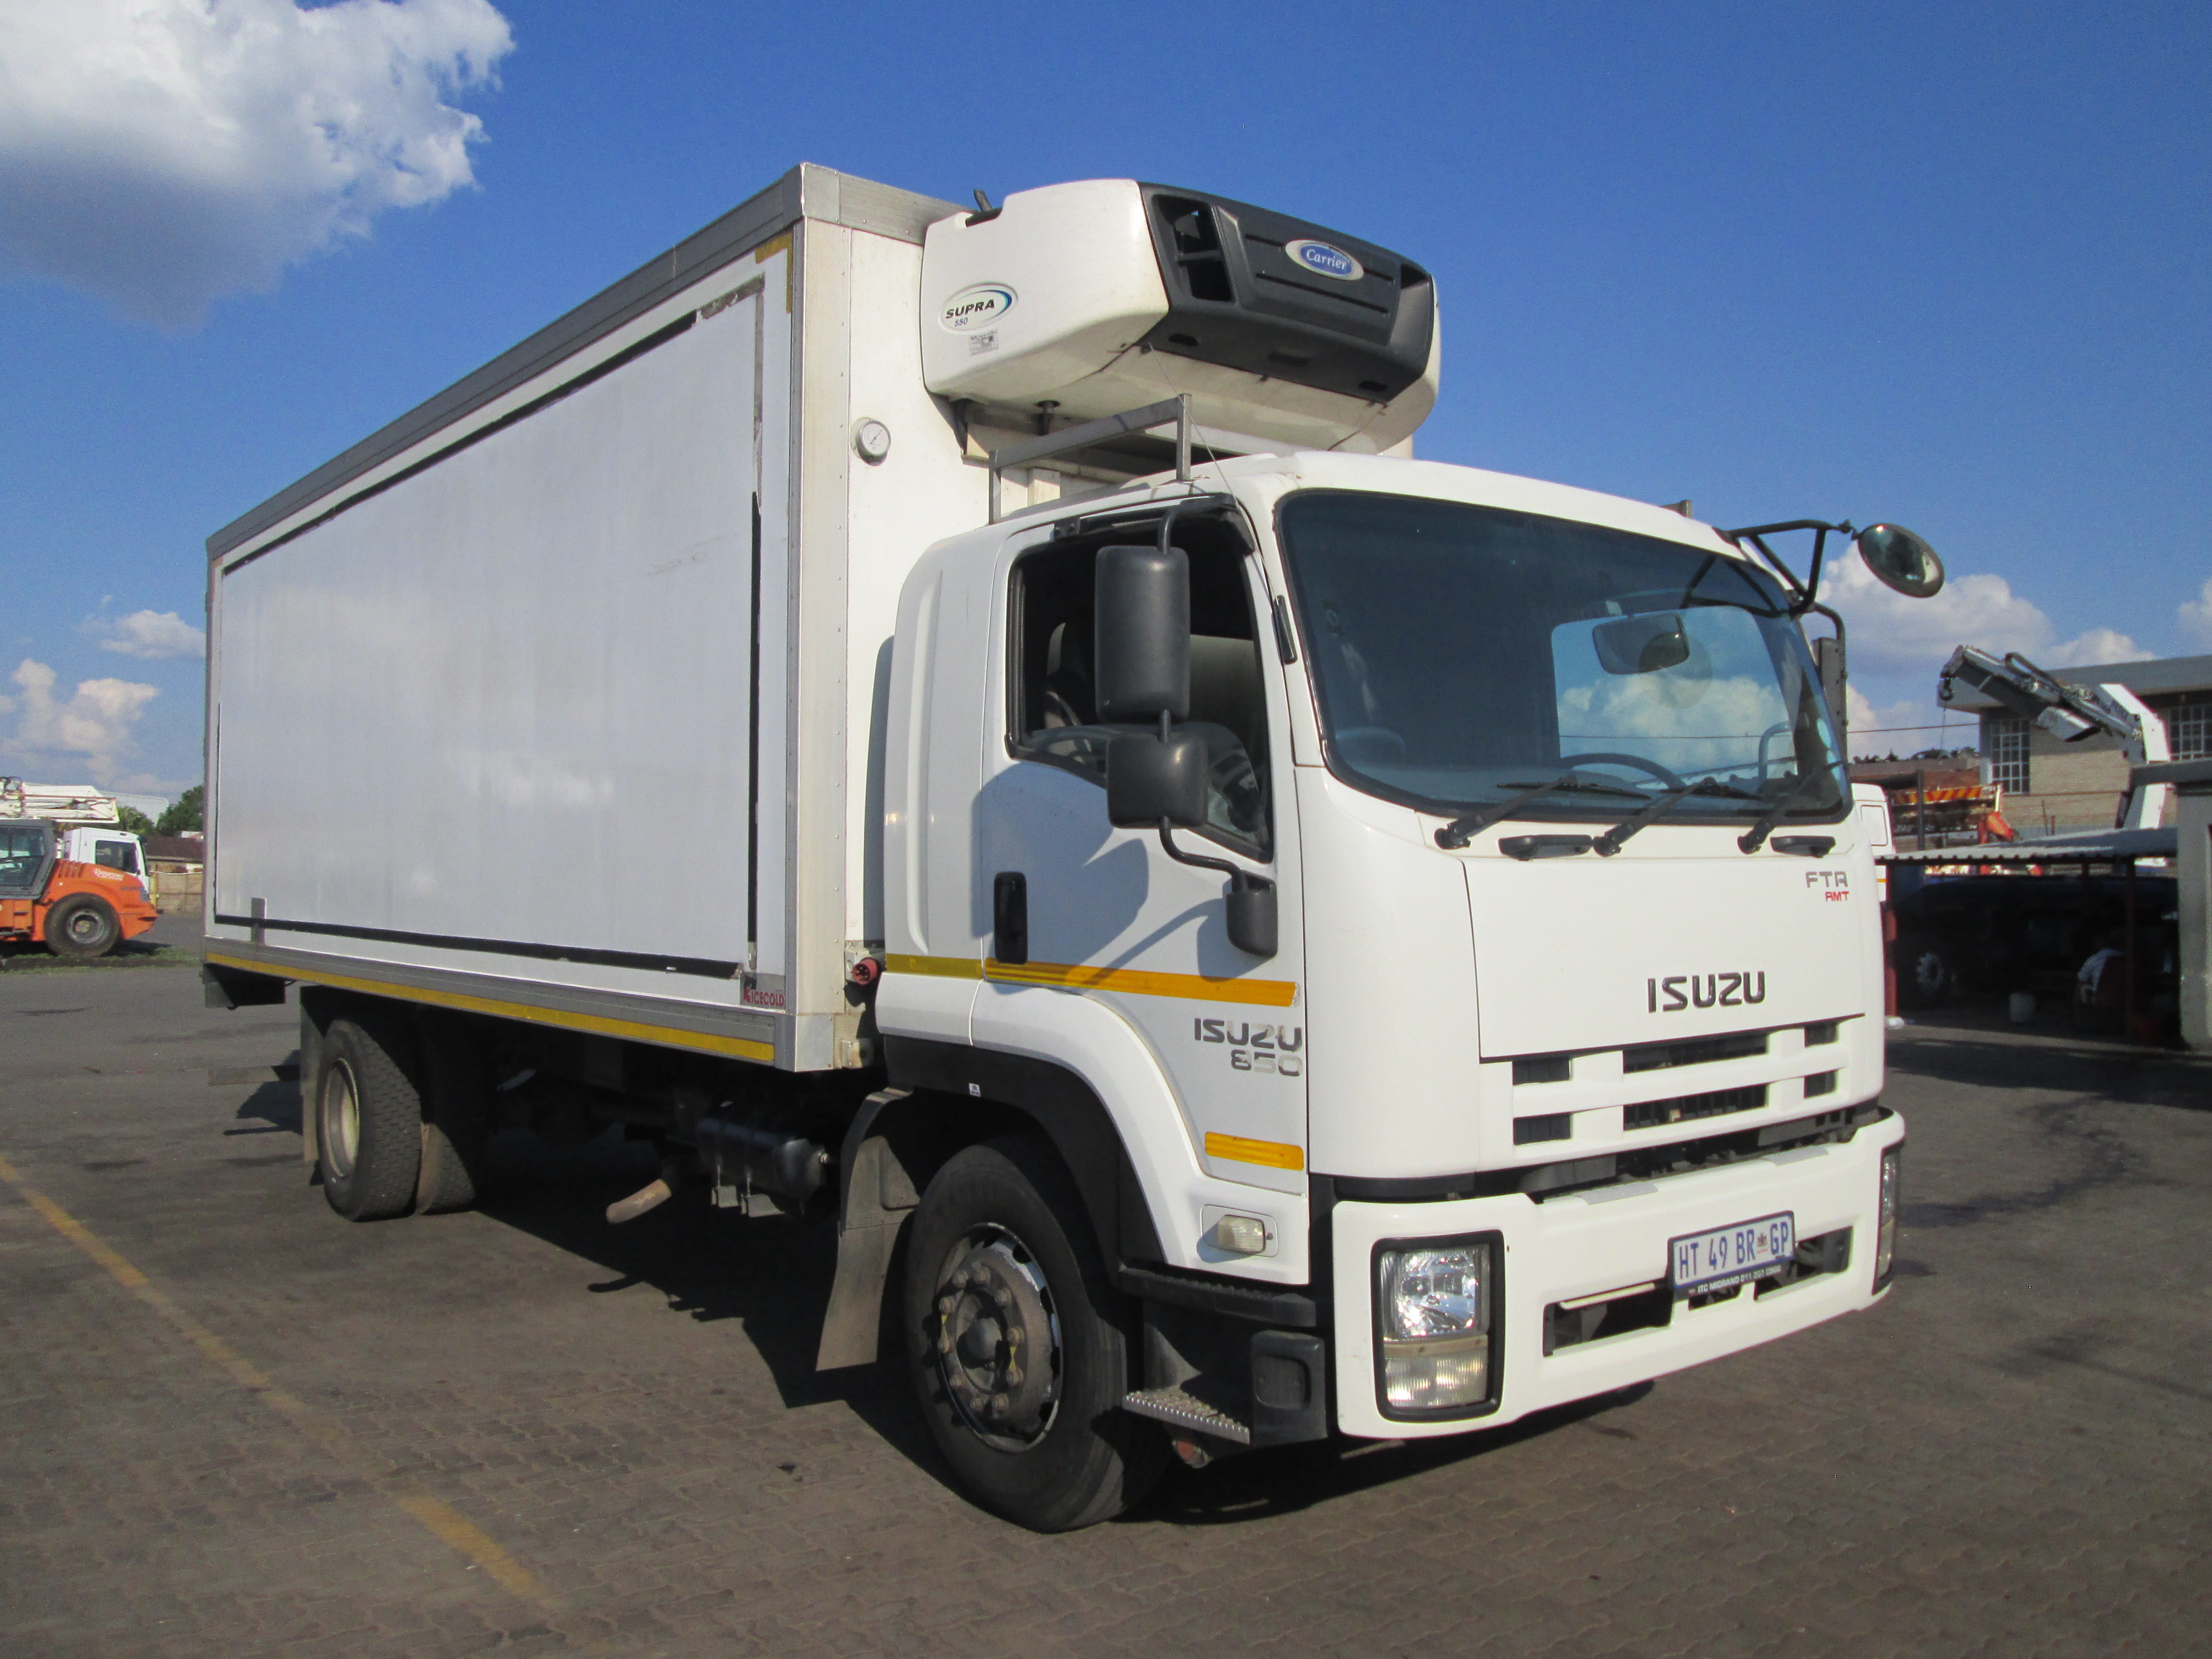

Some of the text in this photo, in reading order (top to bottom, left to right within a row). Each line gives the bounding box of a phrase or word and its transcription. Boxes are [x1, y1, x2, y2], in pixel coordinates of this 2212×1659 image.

[1306, 249, 1347, 270] Carrier
[945, 299, 995, 319] SUPRA
[954, 317, 968, 327] 550
[1805, 871, 1849, 888] FTR
[751, 990, 785, 1007] ICECOLD
[1647, 971, 1766, 1014] ISUZU
[1194, 1017, 1303, 1052] ISUZU
[1679, 1221, 1790, 1279] HT 49 BR GP
